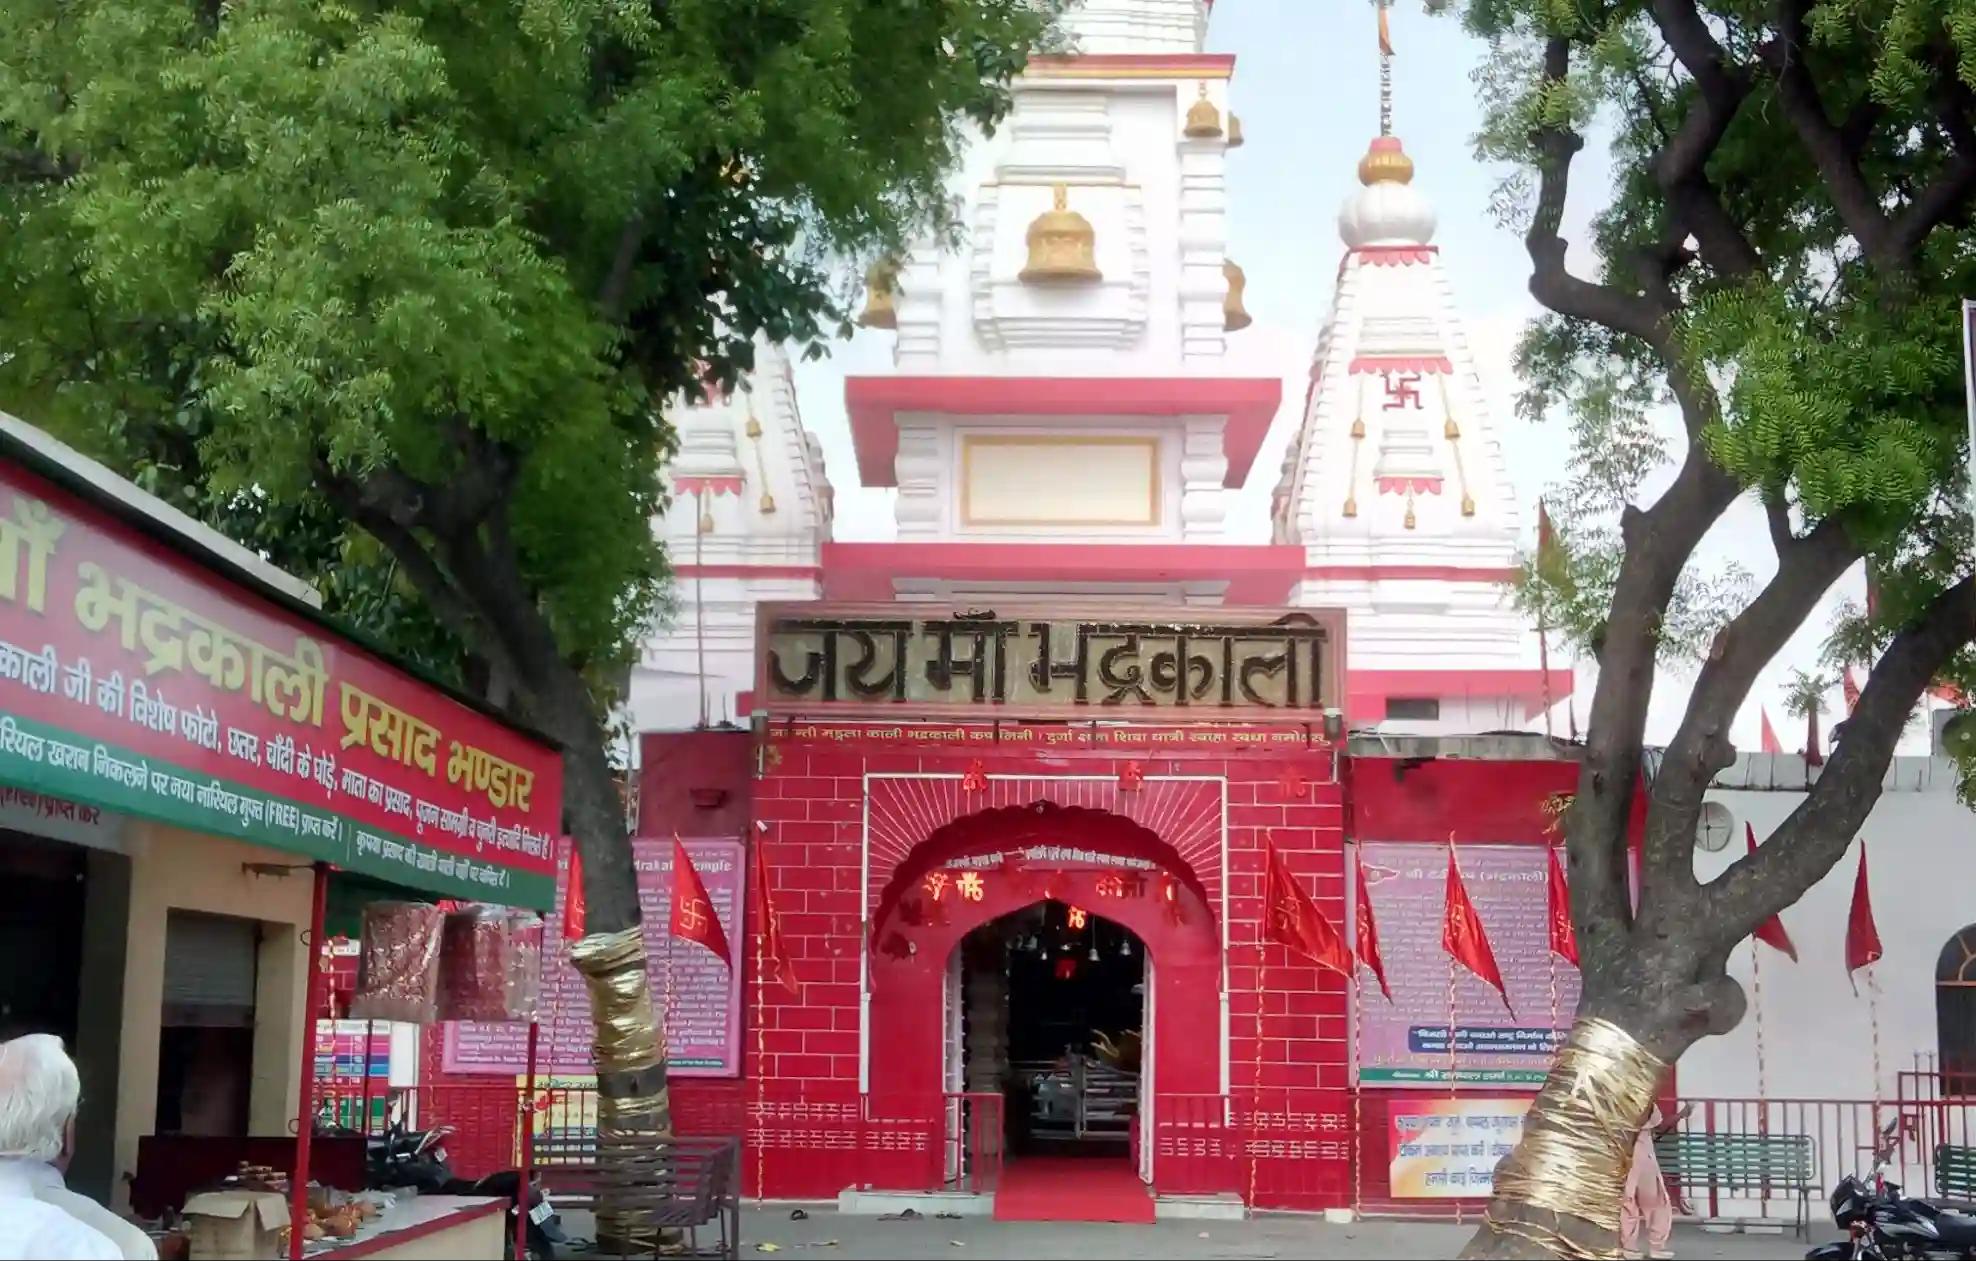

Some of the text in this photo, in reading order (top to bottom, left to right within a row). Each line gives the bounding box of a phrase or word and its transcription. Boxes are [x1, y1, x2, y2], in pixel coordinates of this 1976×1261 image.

[75, 561, 329, 728] भद्रकाली
[340, 681, 442, 777] प्रसाद
[447, 740, 535, 812] भण्डार
[769, 620, 912, 701] जय
[1029, 612, 1327, 707] भद्रकाली
[64, 656, 91, 704] जी
[97, 670, 124, 717] की
[130, 679, 177, 736] विशेष
[297, 744, 313, 779] के
[151, 772, 169, 798] पर
[170, 776, 194, 803] नया
[264, 800, 300, 836] (FREE)
